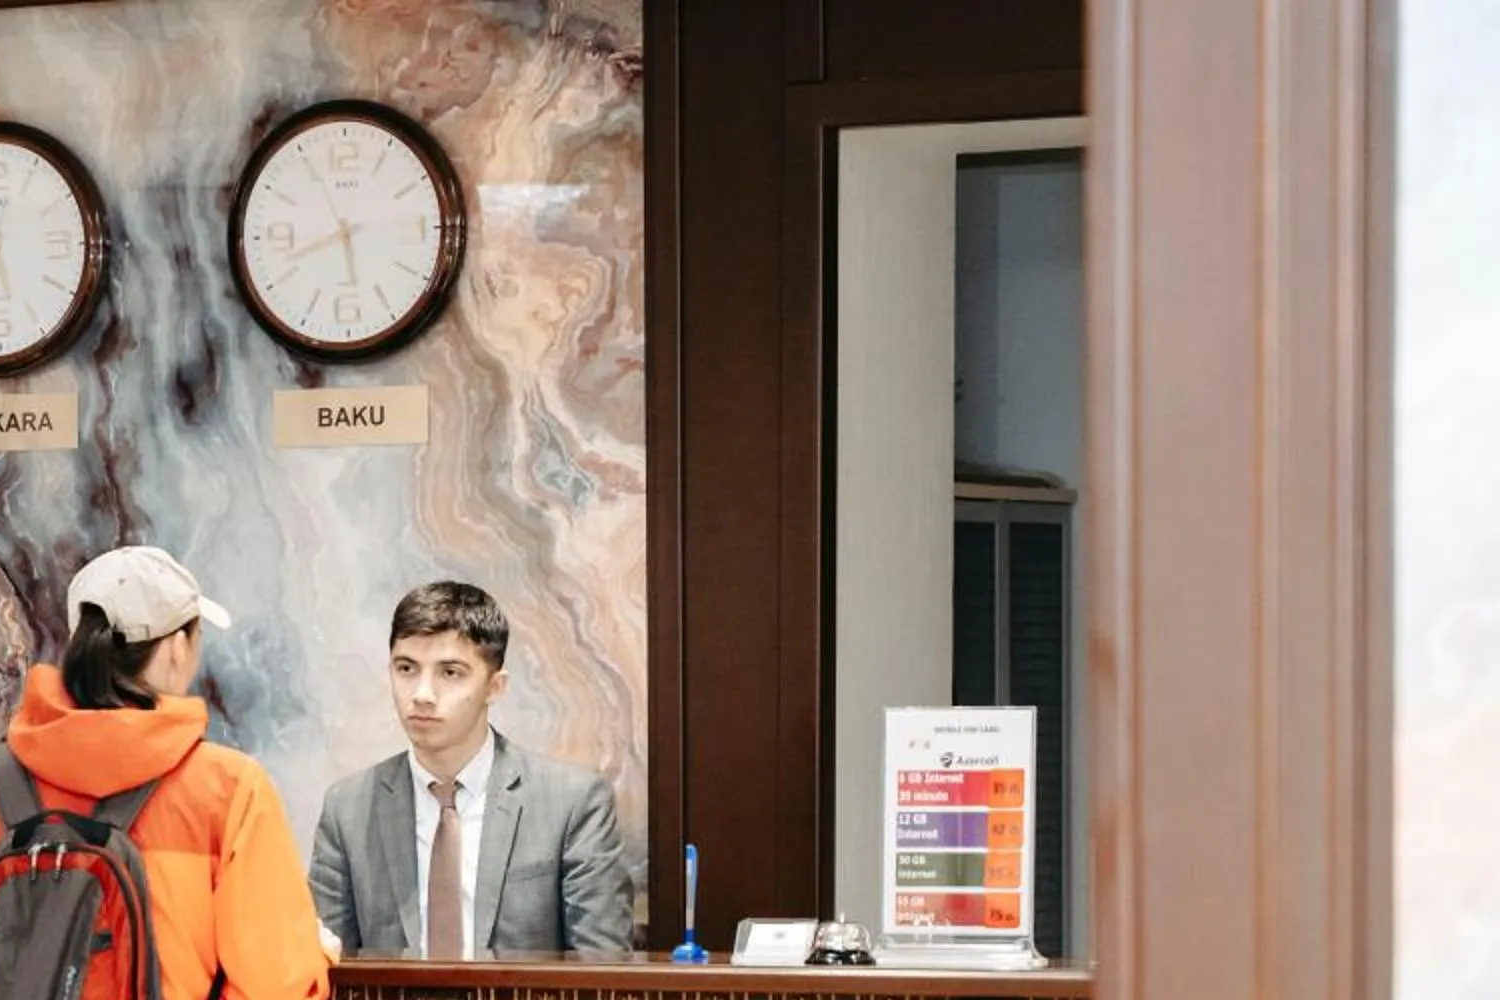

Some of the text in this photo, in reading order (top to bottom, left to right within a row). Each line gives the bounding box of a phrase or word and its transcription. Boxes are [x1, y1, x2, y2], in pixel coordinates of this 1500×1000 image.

[330, 143, 360, 173] 12
[46, 231, 71, 260] 3
[267, 222, 294, 251] 9
[334, 294, 361, 324] 6
[317, 405, 386, 428] BAKU
